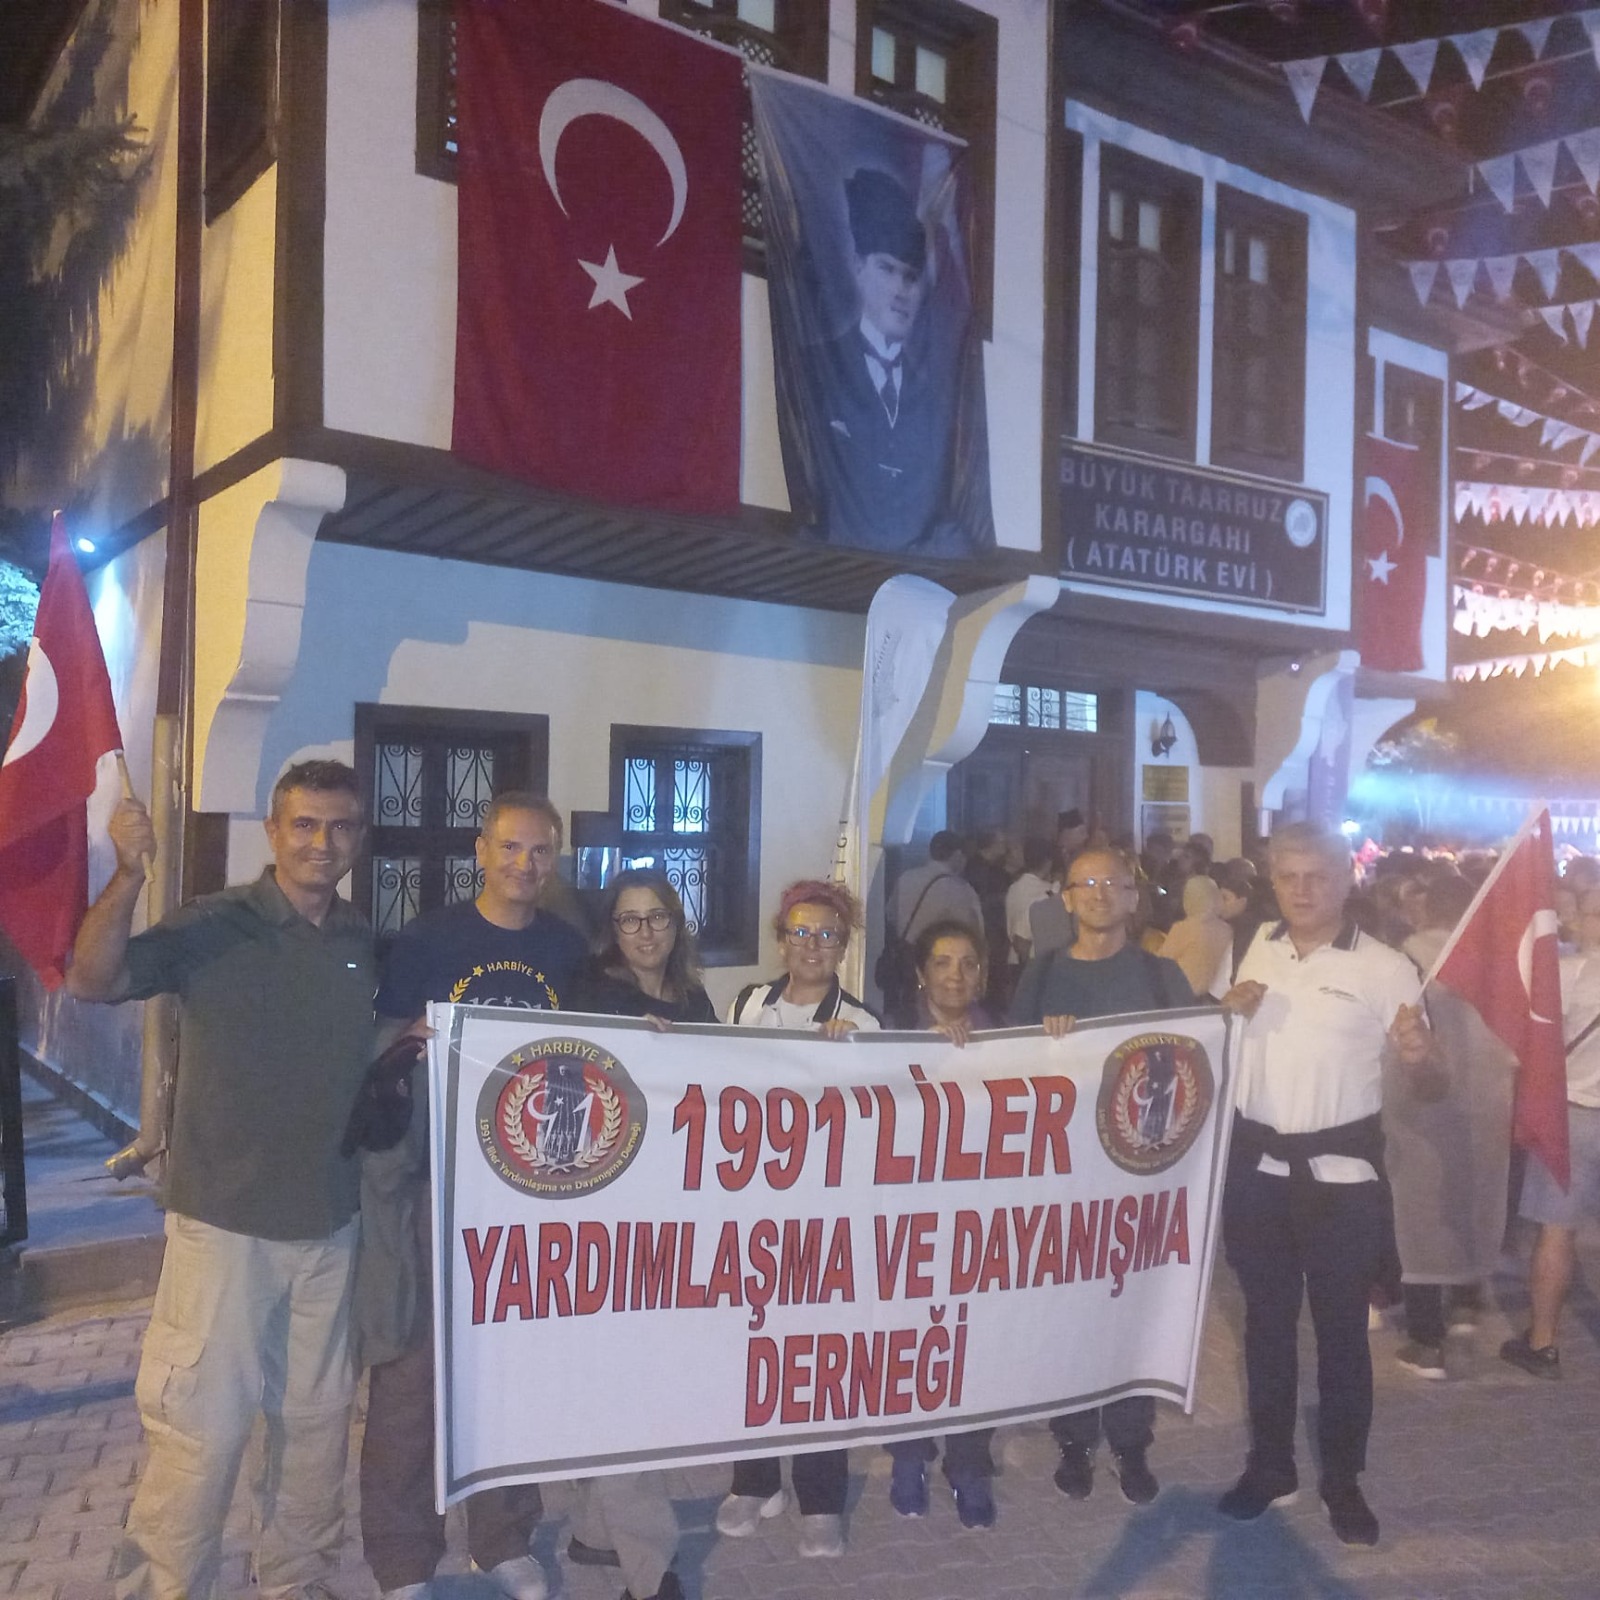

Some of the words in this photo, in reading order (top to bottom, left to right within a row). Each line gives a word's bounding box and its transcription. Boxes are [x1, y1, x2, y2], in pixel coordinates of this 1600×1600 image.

[1060, 455, 1155, 499] BÜYÜK
[1166, 477, 1283, 524] TAARRUZ
[1095, 503, 1250, 555] KARARGAHI
[1086, 540, 1208, 585] ATATÜRK
[1217, 561, 1256, 591] EVİ
[486, 960, 534, 977] HARBİYE
[530, 1040, 600, 1062] HARBİYE
[500, 1162, 558, 1192] Yardımlaşma
[560, 1184, 573, 1192] ve
[575, 1160, 624, 1189] Dayanışma
[621, 1122, 642, 1159] Derneği
[672, 1064, 1076, 1192] 1991'LİLER
[462, 1218, 854, 1331] YARDIMLAŞMA
[874, 1211, 938, 1300] VE
[949, 1187, 1191, 1298] DAYANIŞMA
[744, 1302, 968, 1427] DERNEĞİ
